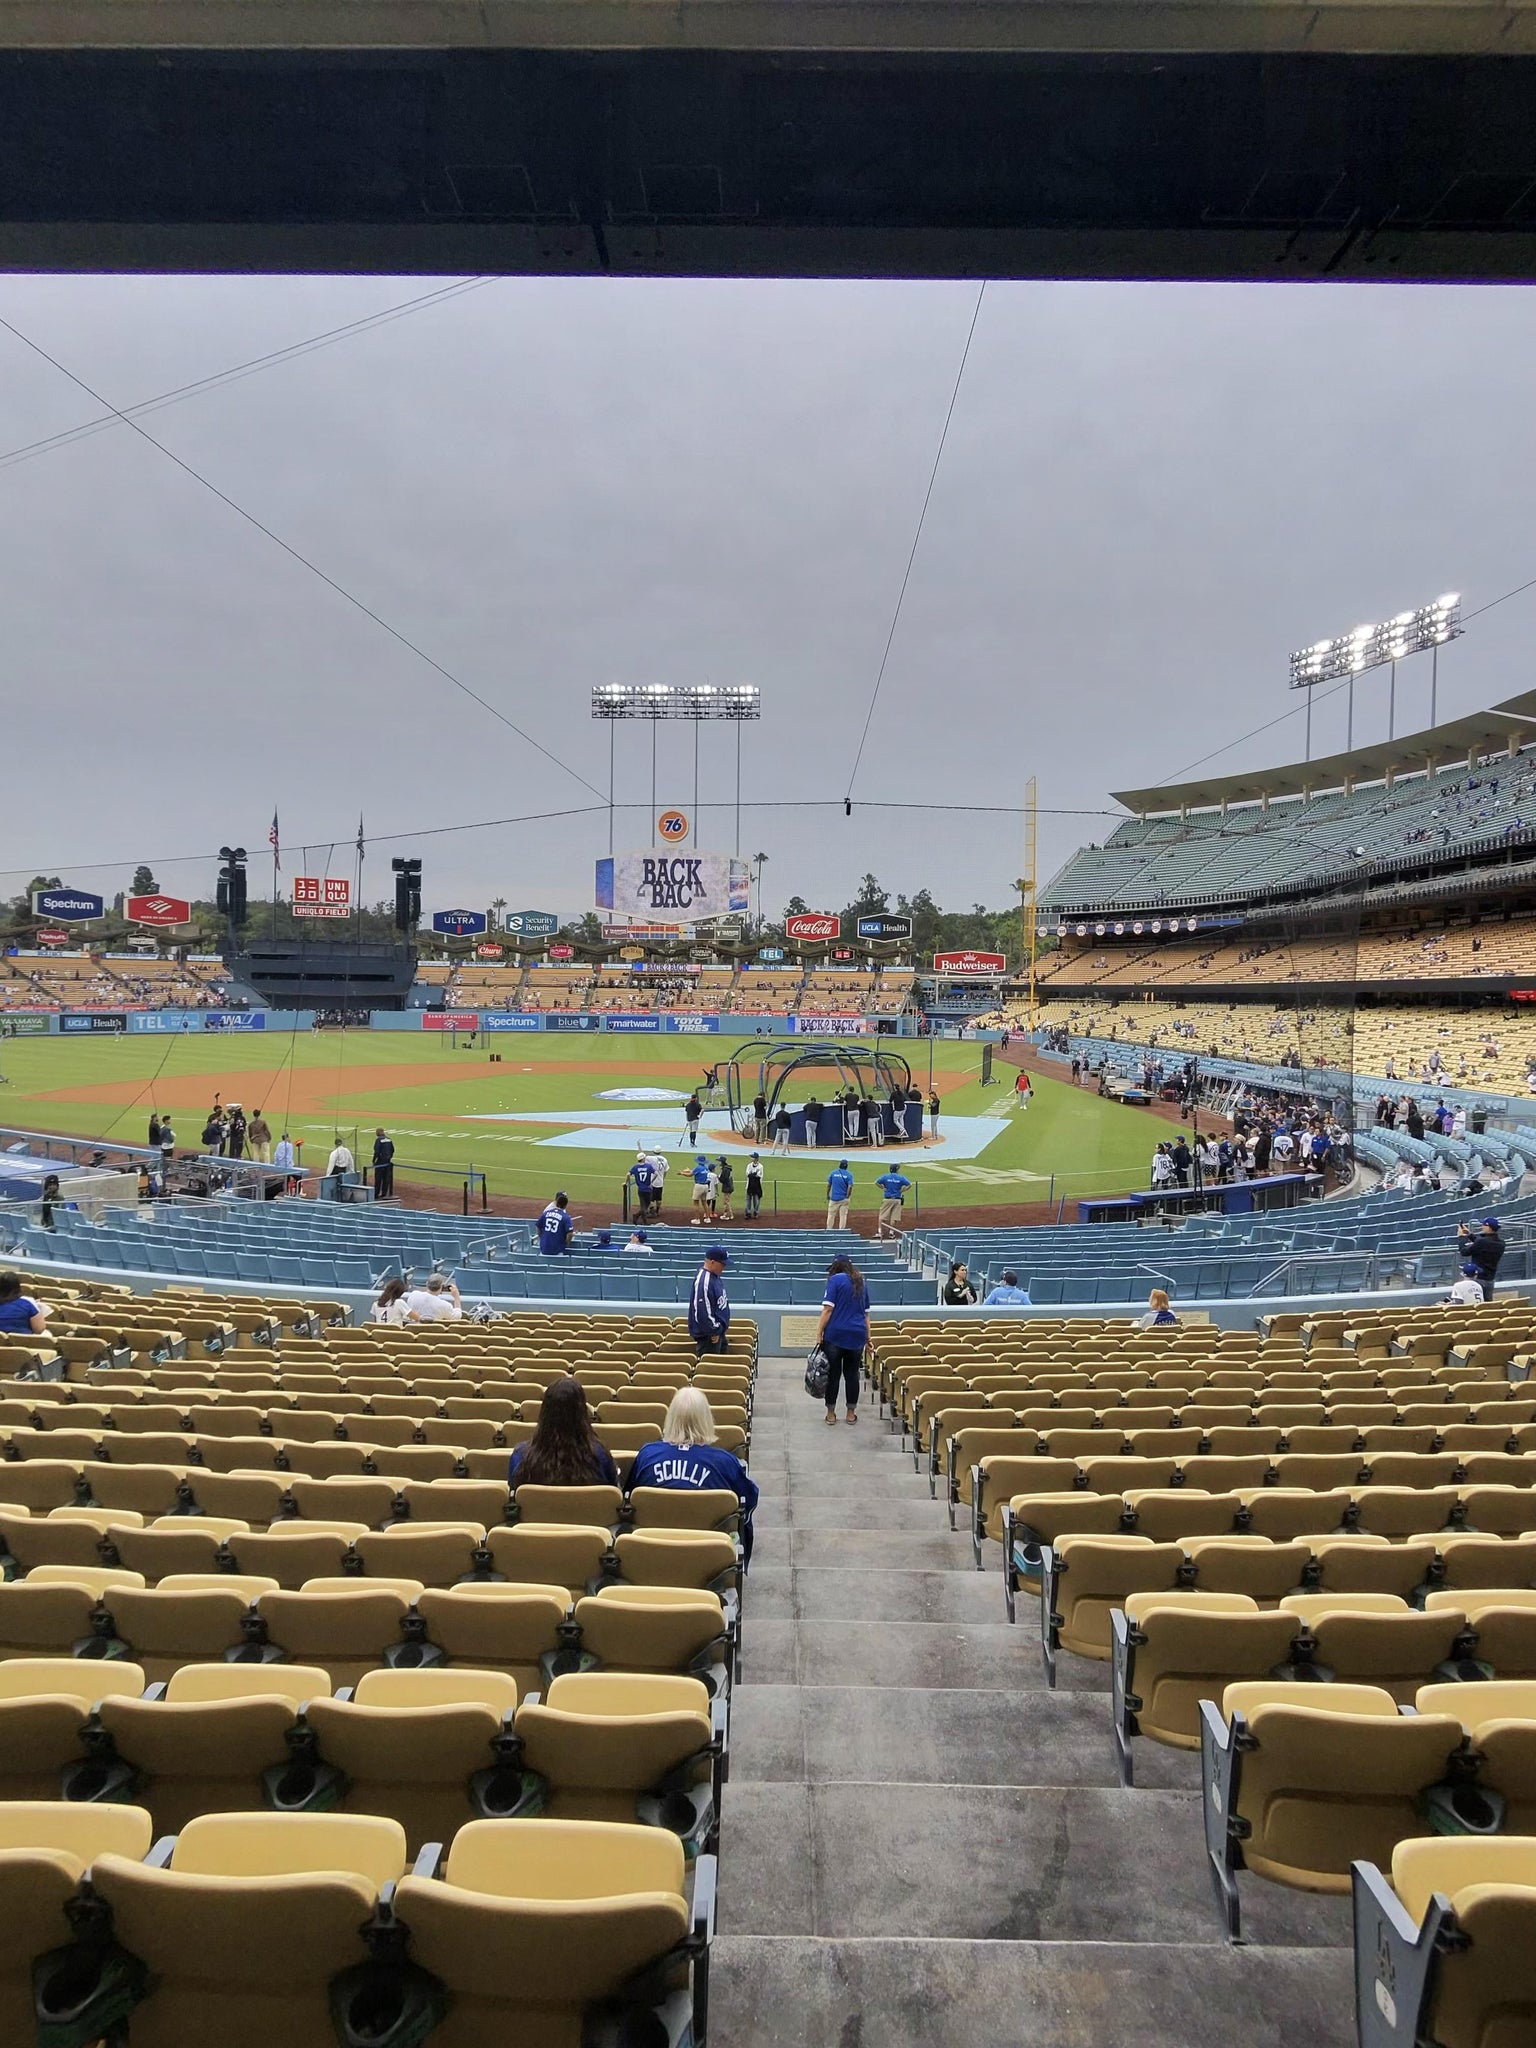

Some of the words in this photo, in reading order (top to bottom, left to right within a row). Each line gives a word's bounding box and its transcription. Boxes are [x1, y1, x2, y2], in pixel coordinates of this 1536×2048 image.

[664, 817, 684, 833] 76
[642, 858, 702, 885] BACK
[327, 882, 345, 891] UNI
[327, 891, 347, 901] QLO
[43, 897, 94, 910] Spectrum
[296, 907, 324, 916] UNIQLO
[325, 908, 347, 916] FIELD
[444, 916, 475, 925] ULTRA
[525, 916, 554, 924] Security
[791, 920, 834, 935] Coca-Cola
[882, 924, 908, 932] Health
[762, 951, 780, 959] TEL
[941, 960, 998, 970] Budweiser
[67, 1019, 88, 1027] UCLA
[93, 1018, 122, 1028] Health
[135, 1016, 166, 1029] TEL
[219, 1015, 241, 1024] ANA
[487, 1016, 533, 1027] Spectrum
[558, 1017, 579, 1026] blue
[673, 1017, 703, 1025] TOYO
[678, 1024, 709, 1032] TIRES
[800, 1019, 825, 1031] BACK
[475, 1134, 544, 1143] FIEL
[639, 1172, 648, 1182] 17
[544, 1218, 560, 1233] 53
[380, 1310, 388, 1323] 4
[653, 1459, 711, 1487] SCULLY
